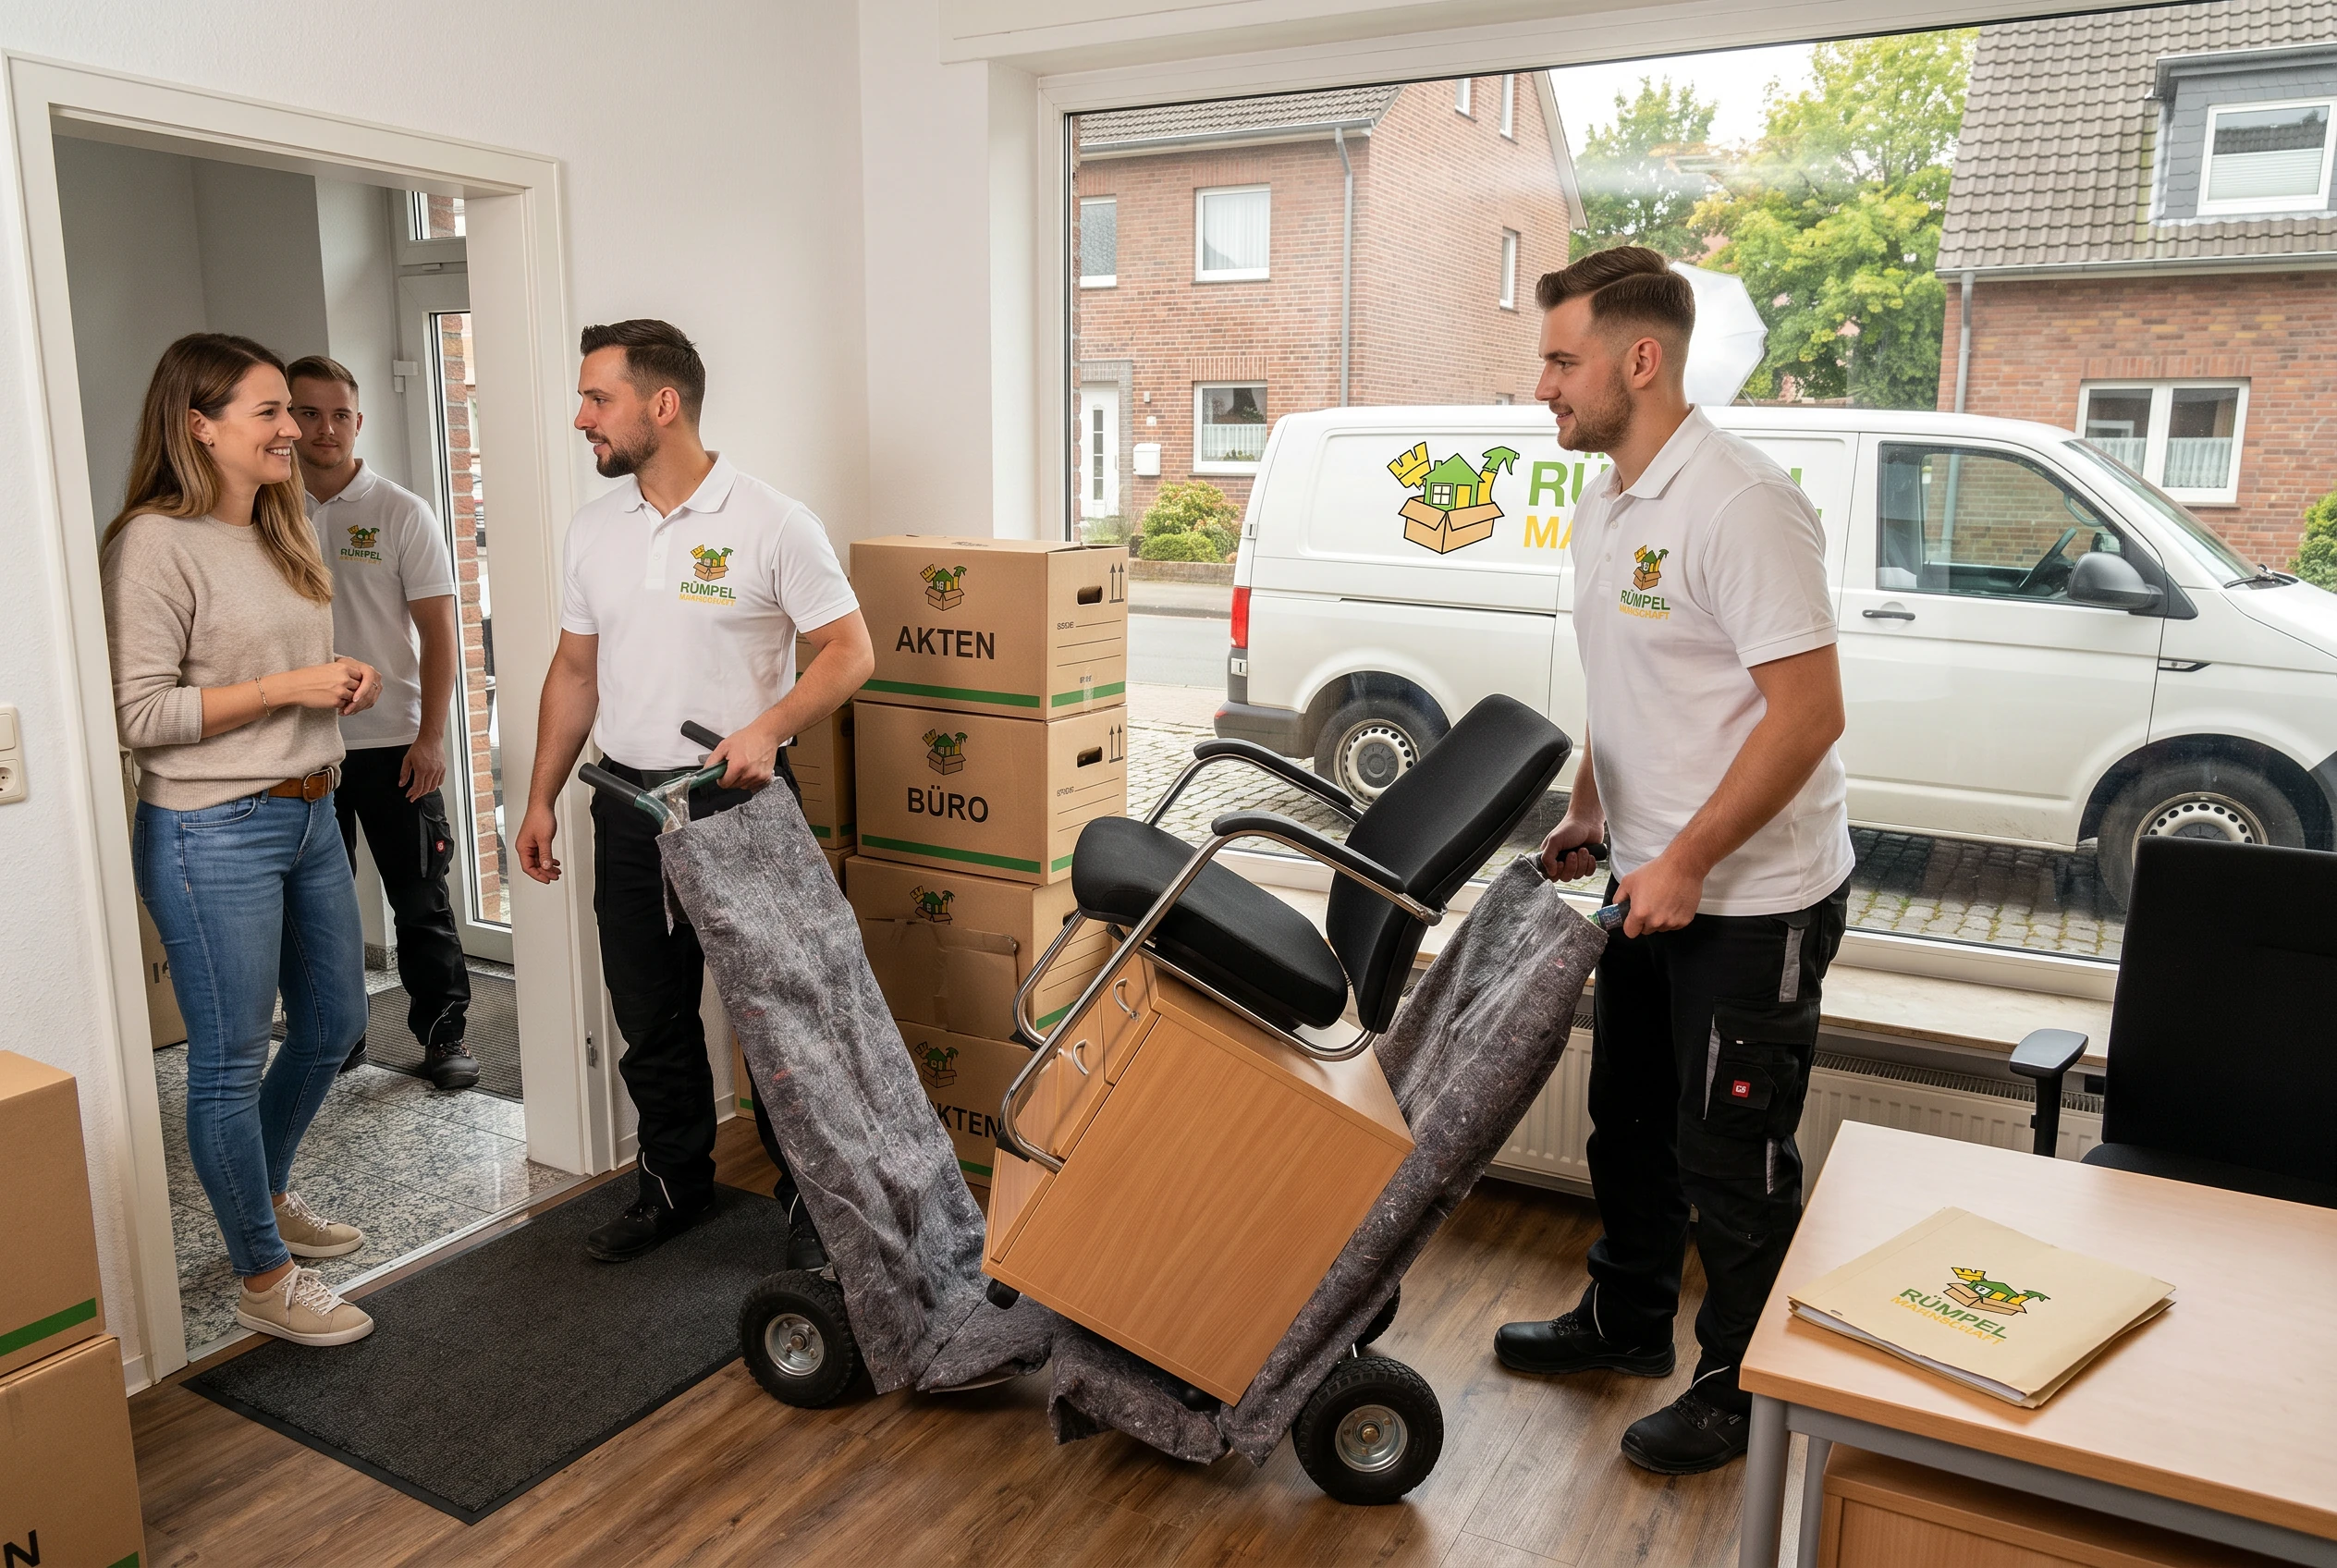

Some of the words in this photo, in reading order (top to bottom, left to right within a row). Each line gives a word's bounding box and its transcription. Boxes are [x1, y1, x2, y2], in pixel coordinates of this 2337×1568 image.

[679, 580, 737, 600] RÜMPEL
[1620, 588, 1671, 611] RÜMPEL
[895, 625, 995, 660] AKTEN
[907, 784, 989, 823] BÜRO
[926, 1096, 1003, 1139] KTEN
[1899, 1288, 2007, 1340] RÜMPEL
